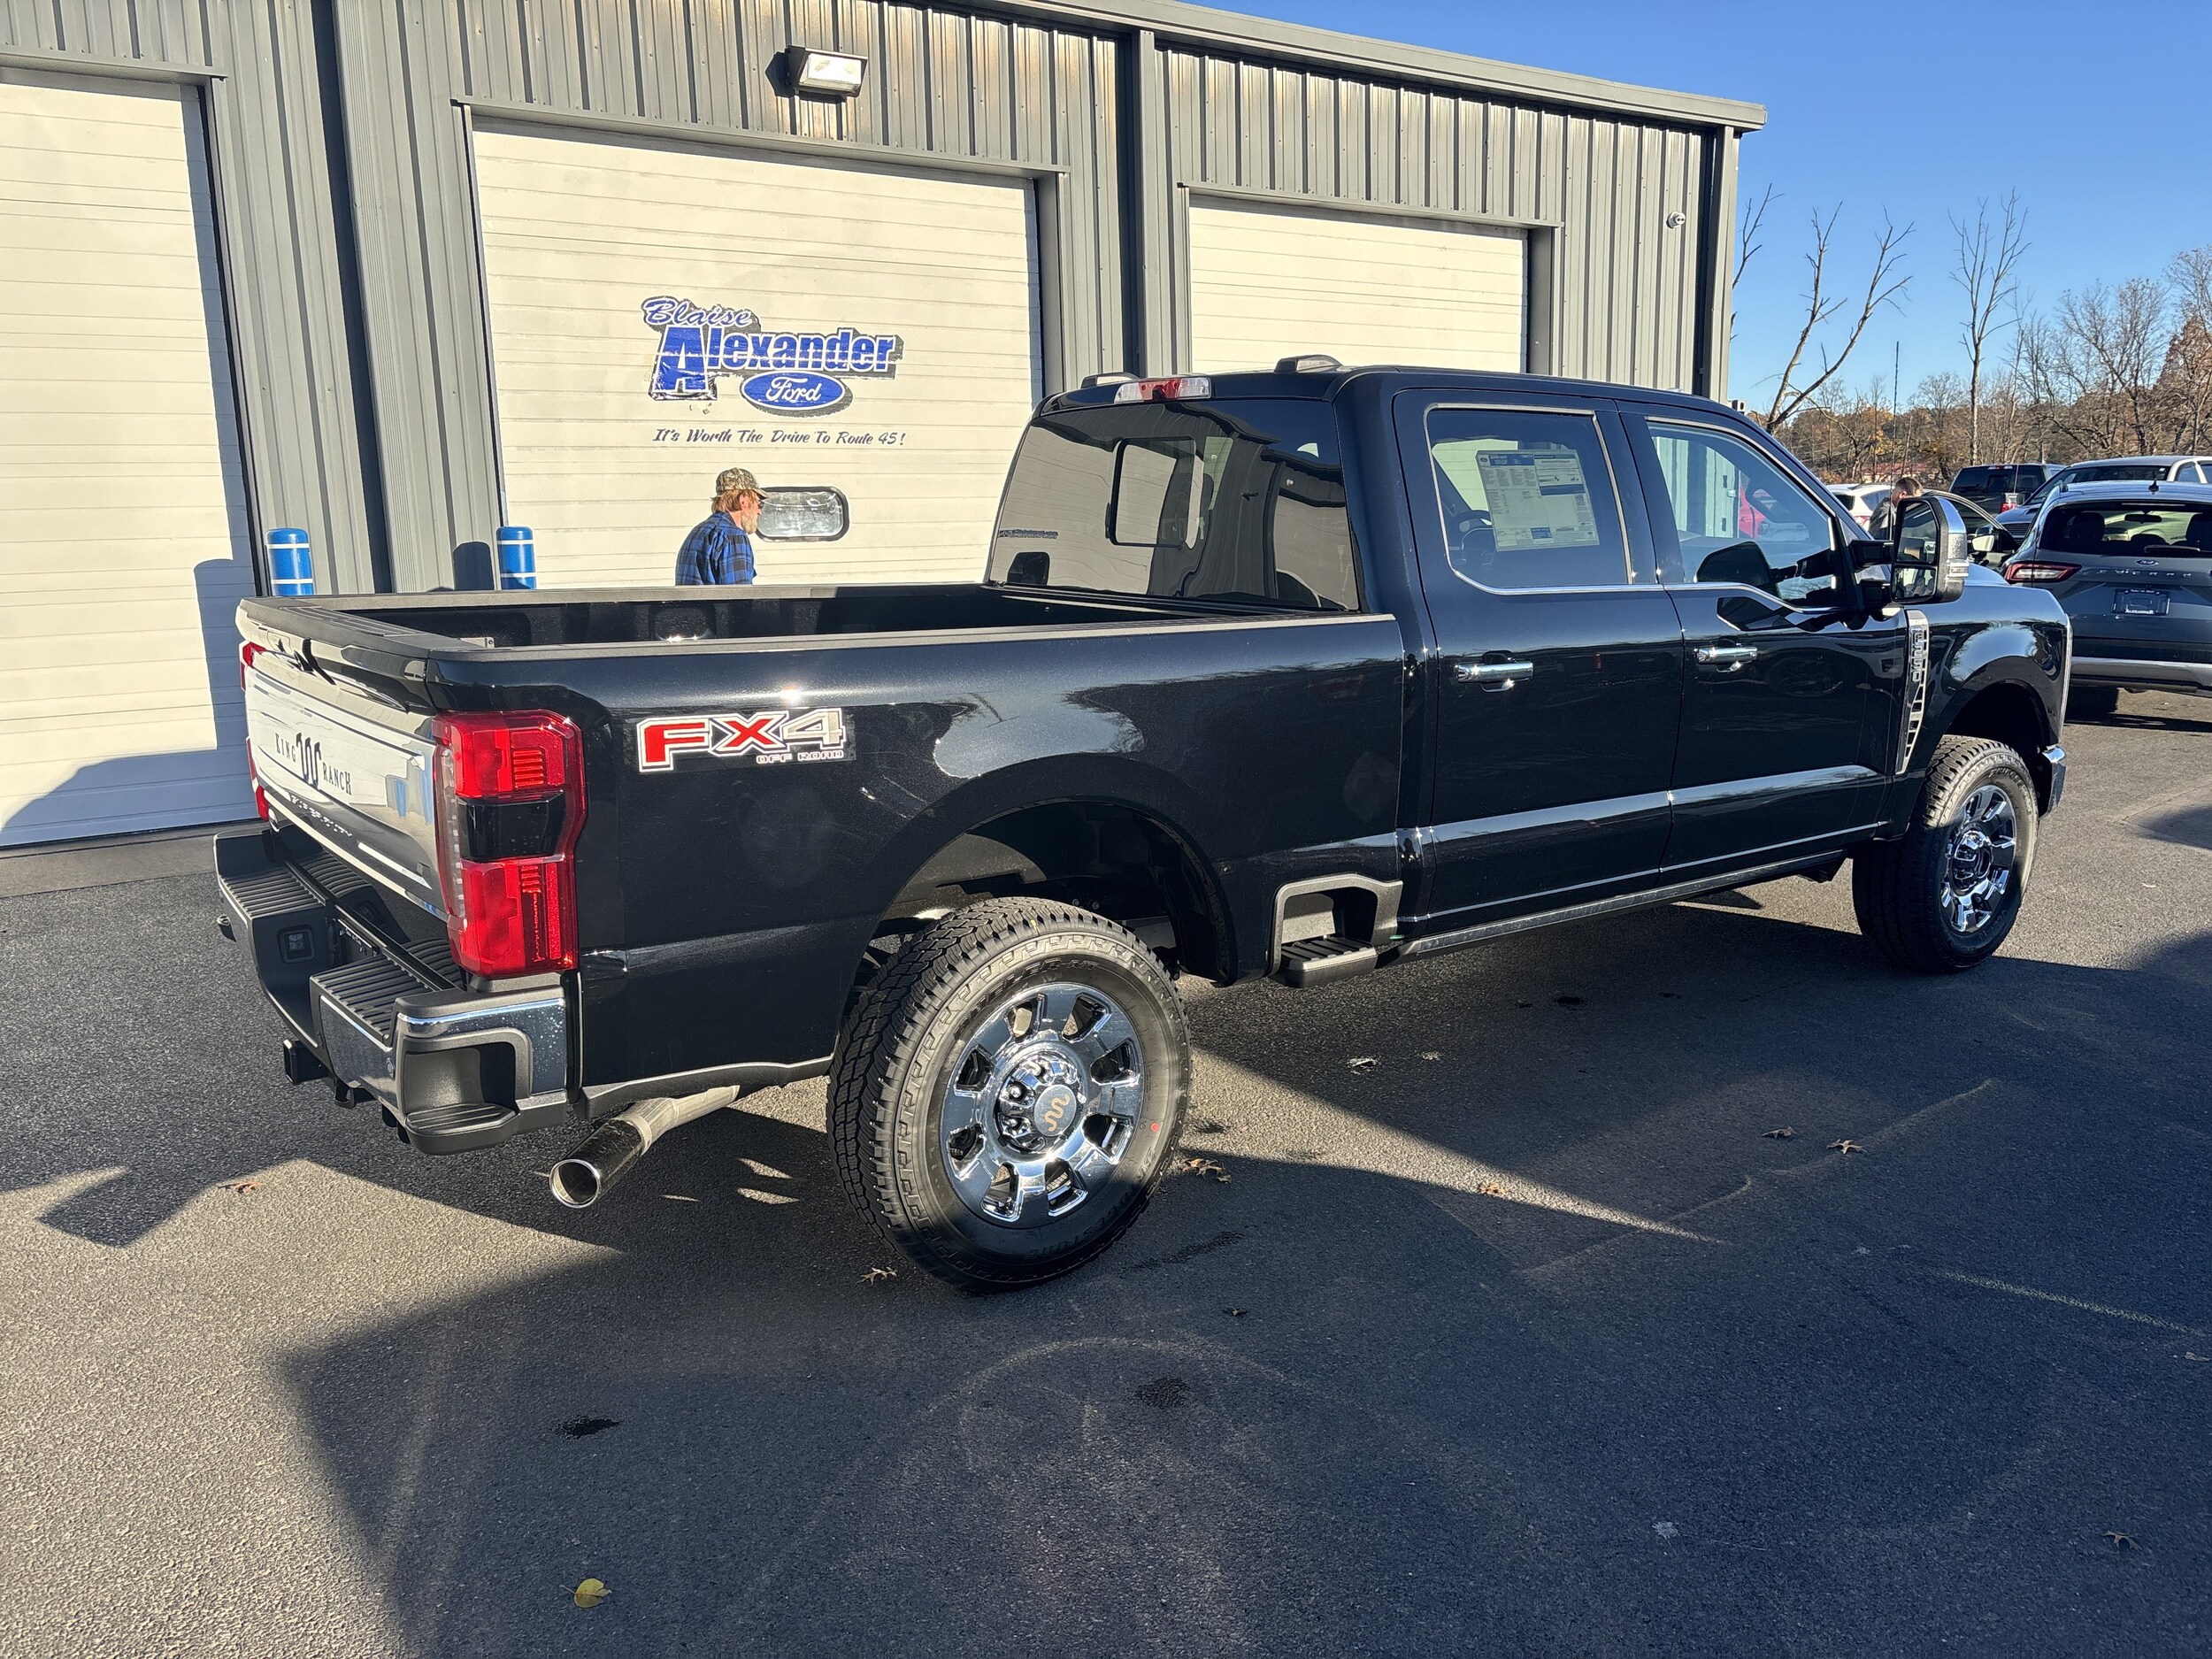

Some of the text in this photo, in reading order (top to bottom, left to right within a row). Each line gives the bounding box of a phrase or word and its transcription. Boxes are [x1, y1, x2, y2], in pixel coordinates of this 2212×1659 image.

[643, 299, 752, 327] Blaise
[651, 324, 897, 393] Alexander
[765, 376, 822, 402] Ford
[652, 428, 907, 446] It's Worth The Drive To Route 45!
[636, 708, 846, 772] FX4
[275, 732, 352, 795] KING RANCH
[757, 750, 844, 764] OFF ROAD
